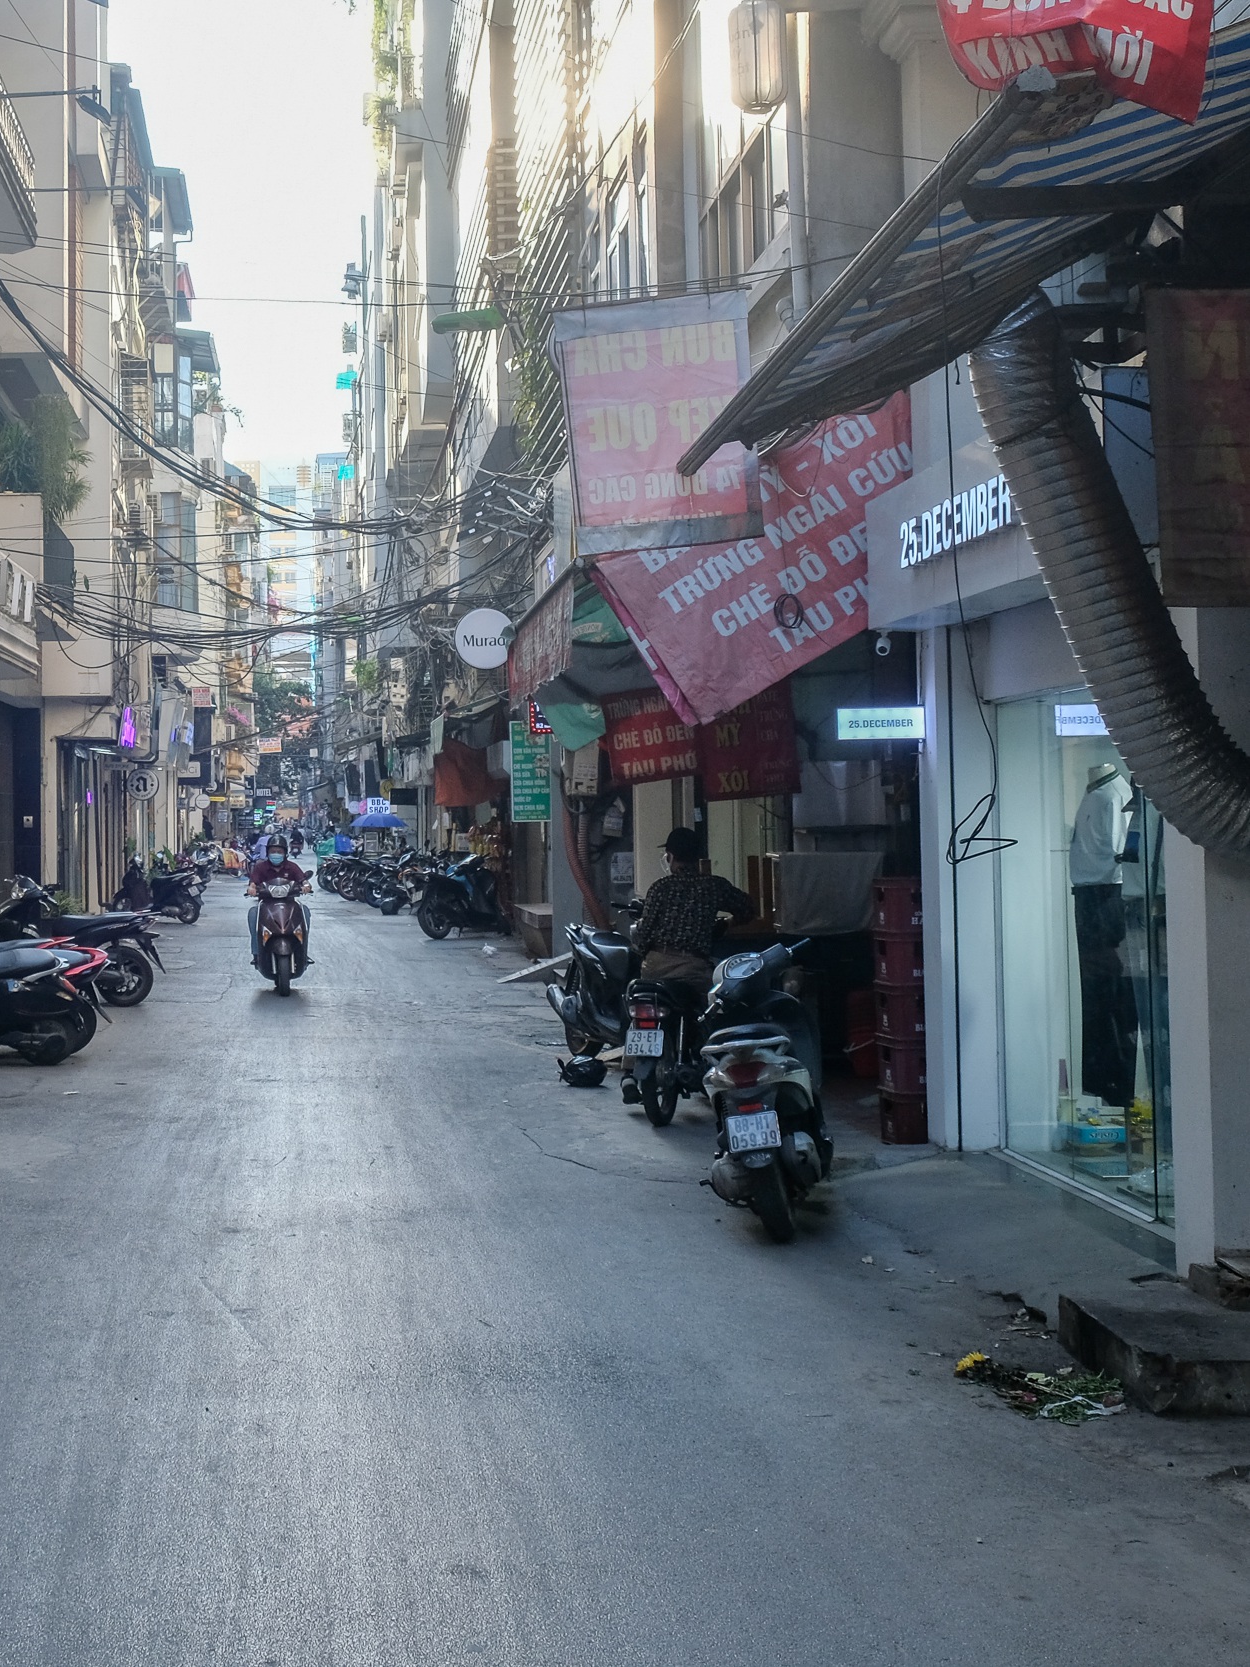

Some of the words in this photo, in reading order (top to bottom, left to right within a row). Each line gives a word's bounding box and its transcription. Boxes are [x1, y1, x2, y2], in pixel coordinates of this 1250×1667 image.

[961, 28, 1075, 80] KÍNH
[900, 473, 1012, 569] 25.DECEMBER
[657, 538, 765, 614] TRỨNG
[711, 583, 776, 637] CHÈ
[848, 718, 914, 729] 25.DECEMBER
[613, 728, 640, 750] CHÈ
[256, 789, 272, 797] HOTEL
[369, 806, 389, 814] SHOP
[631, 1031, 658, 1043] 29-E1
[627, 1043, 660, 1056] 834.46
[734, 1115, 770, 1134] 88-H1
[731, 1130, 778, 1150] 059.99
